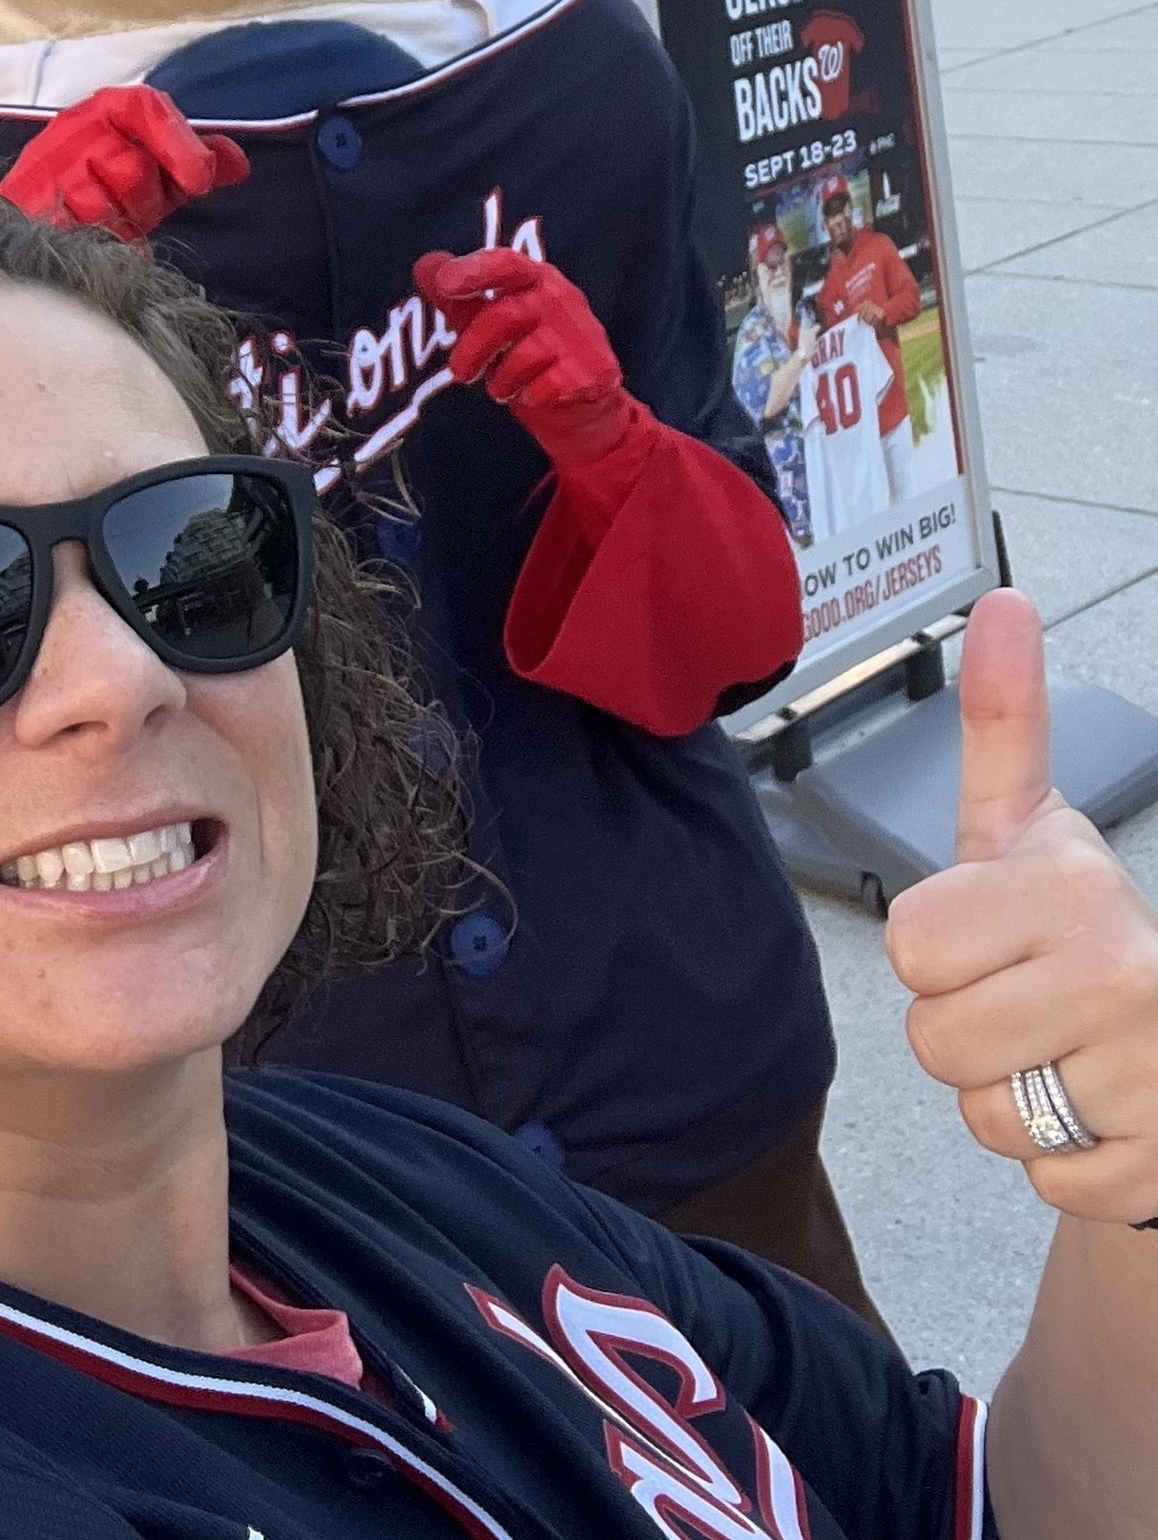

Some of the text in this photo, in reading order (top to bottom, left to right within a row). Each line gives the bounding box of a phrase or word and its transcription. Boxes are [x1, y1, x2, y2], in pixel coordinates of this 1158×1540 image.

[730, 19, 794, 66] OFF THEIR
[734, 57, 822, 142] BACKS
[744, 150, 796, 188] SEPT
[799, 129, 857, 170] 18-23
[815, 362, 862, 436] 40
[803, 502, 957, 597] OW TO WIN BIG!
